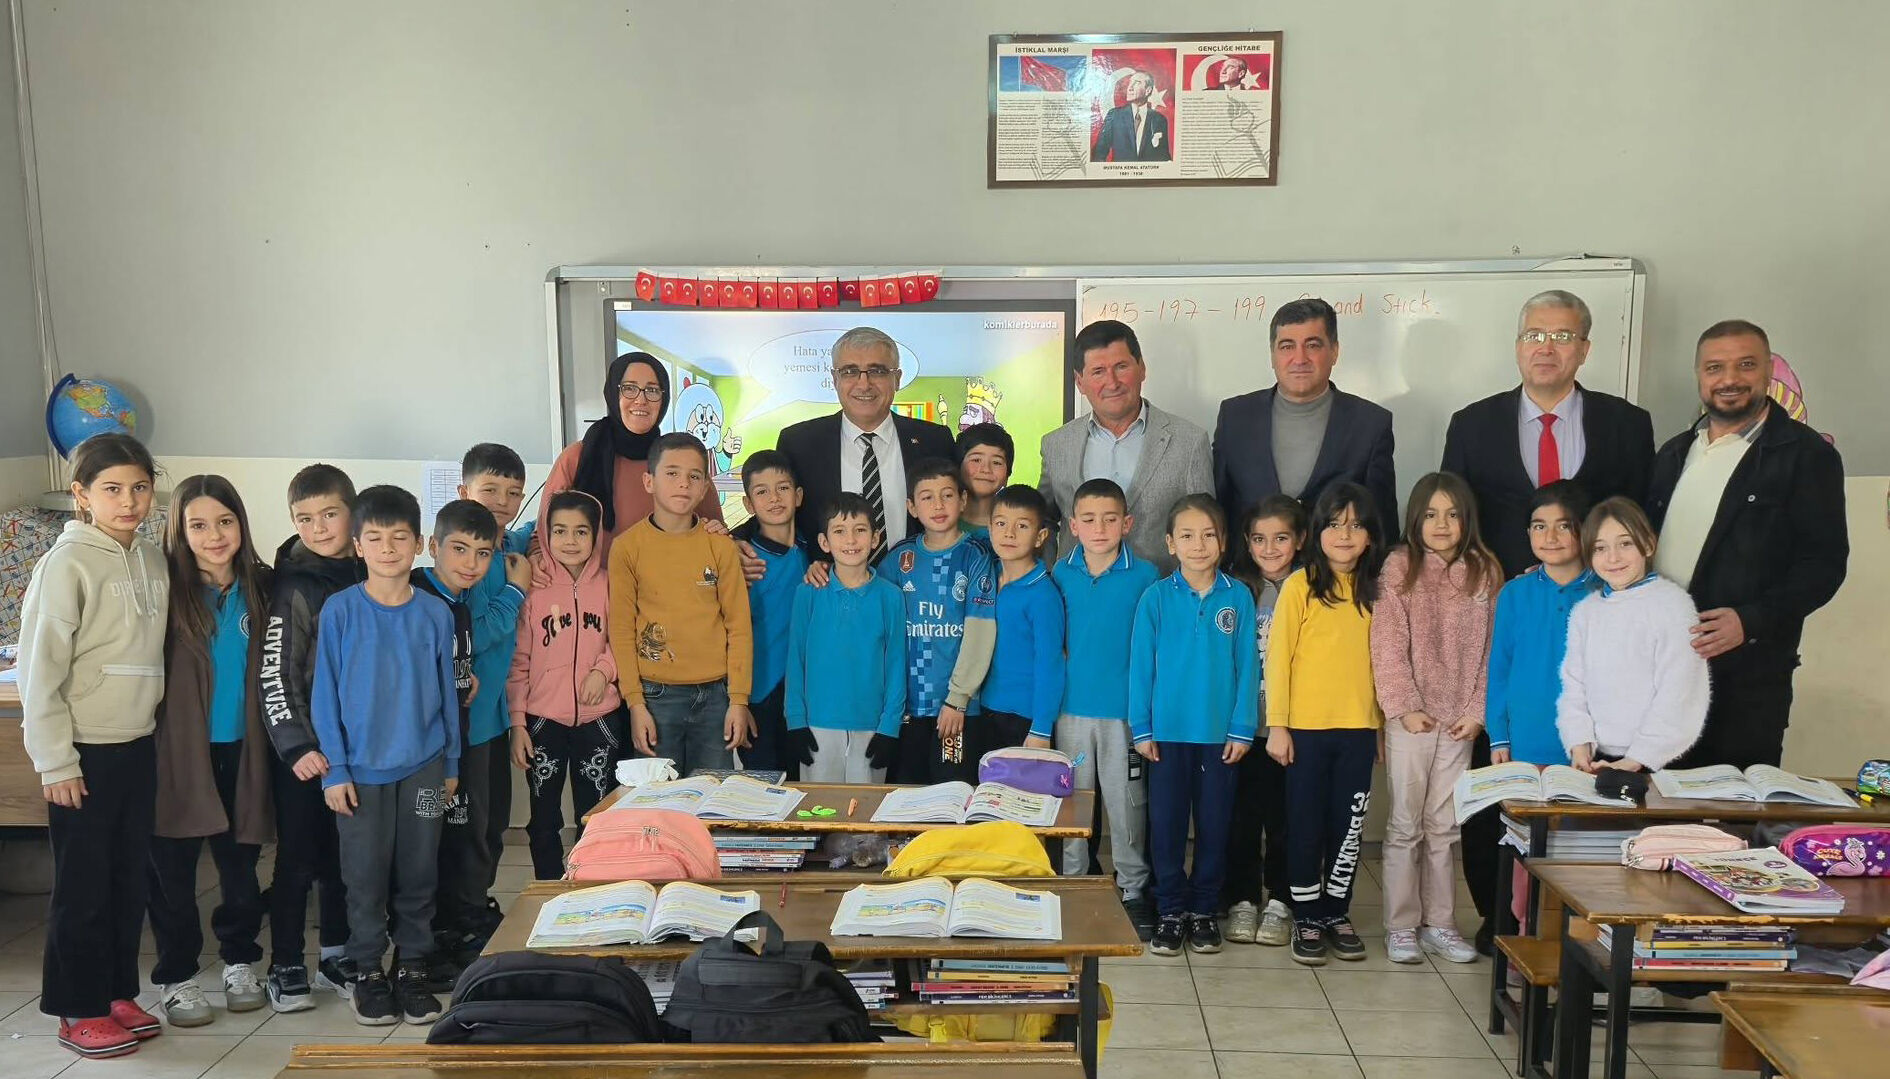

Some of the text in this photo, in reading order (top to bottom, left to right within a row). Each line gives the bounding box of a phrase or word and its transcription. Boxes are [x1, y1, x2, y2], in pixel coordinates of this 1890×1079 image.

[918, 601, 944, 620] Fly
[582, 611, 602, 633] you
[260, 615, 293, 727] ADVENTURE
